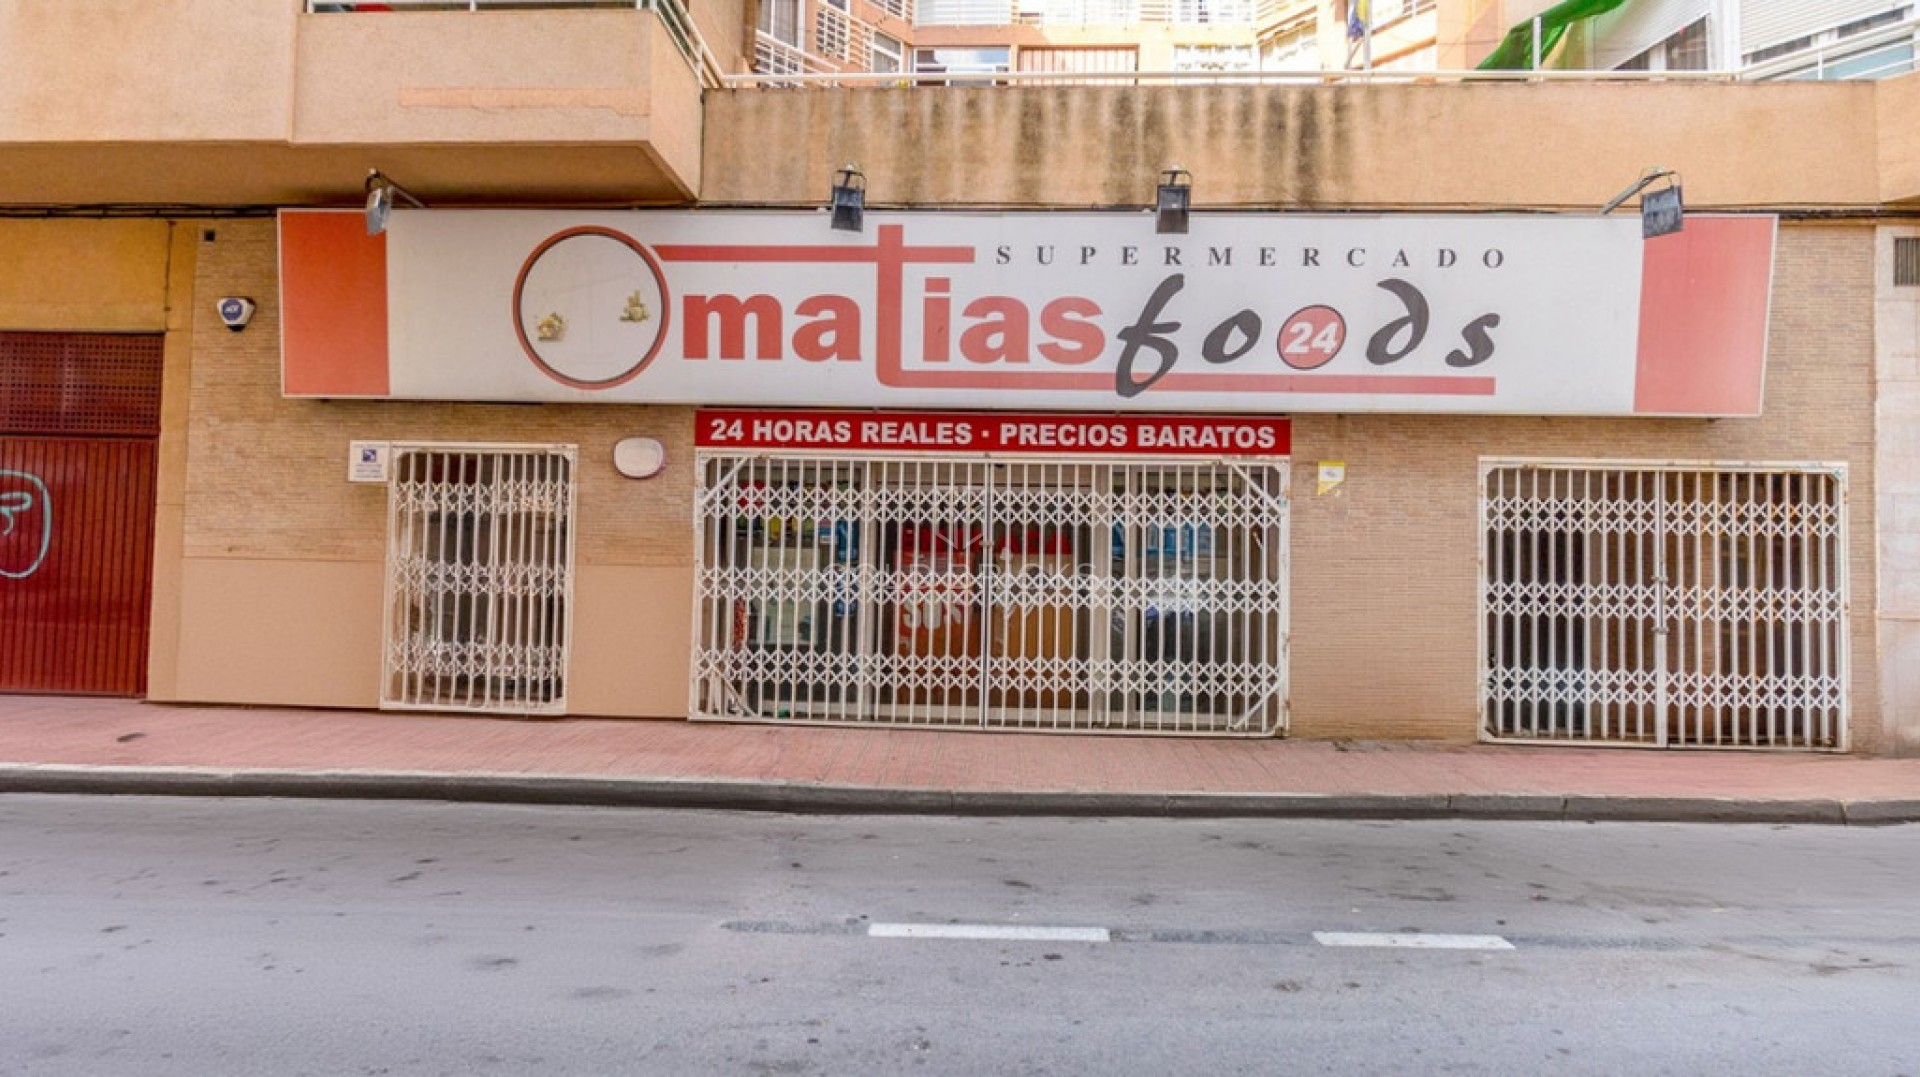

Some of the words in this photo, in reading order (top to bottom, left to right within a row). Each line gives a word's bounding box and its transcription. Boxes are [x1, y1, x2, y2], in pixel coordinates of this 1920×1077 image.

[994, 246, 1503, 268] SUPERMERCADO
[1284, 322, 1340, 353] 24
[710, 419, 744, 441] 24
[752, 421, 851, 443] HORAS
[862, 423, 972, 444] REALES
[1000, 423, 1128, 446] PRECIOS
[1137, 427, 1276, 449] BARATOS
